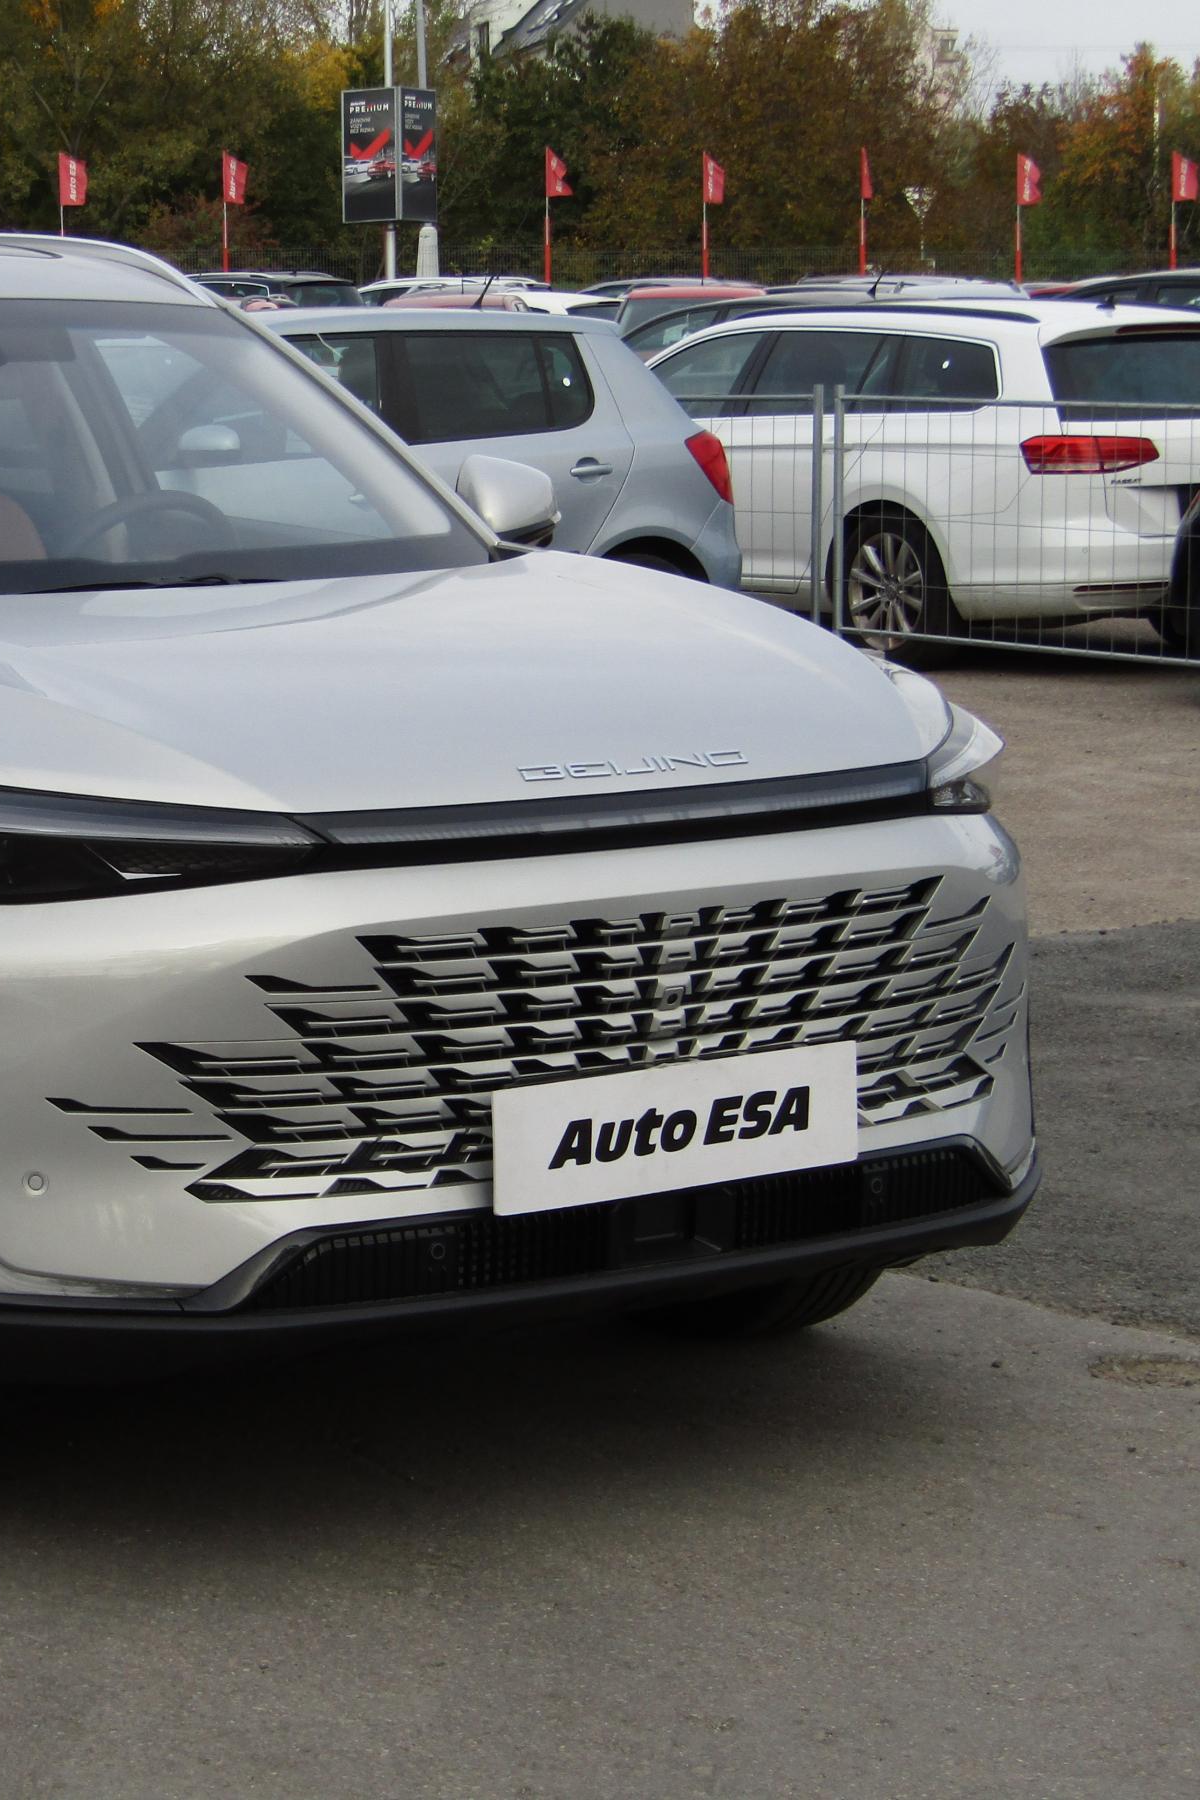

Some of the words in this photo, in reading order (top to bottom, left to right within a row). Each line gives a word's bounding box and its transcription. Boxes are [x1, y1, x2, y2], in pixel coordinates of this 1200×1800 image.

[350, 103, 389, 114] PREMIUM
[517, 748, 749, 782] BEIJING
[548, 1107, 697, 1170] Auto
[703, 1085, 810, 1146] ESA
